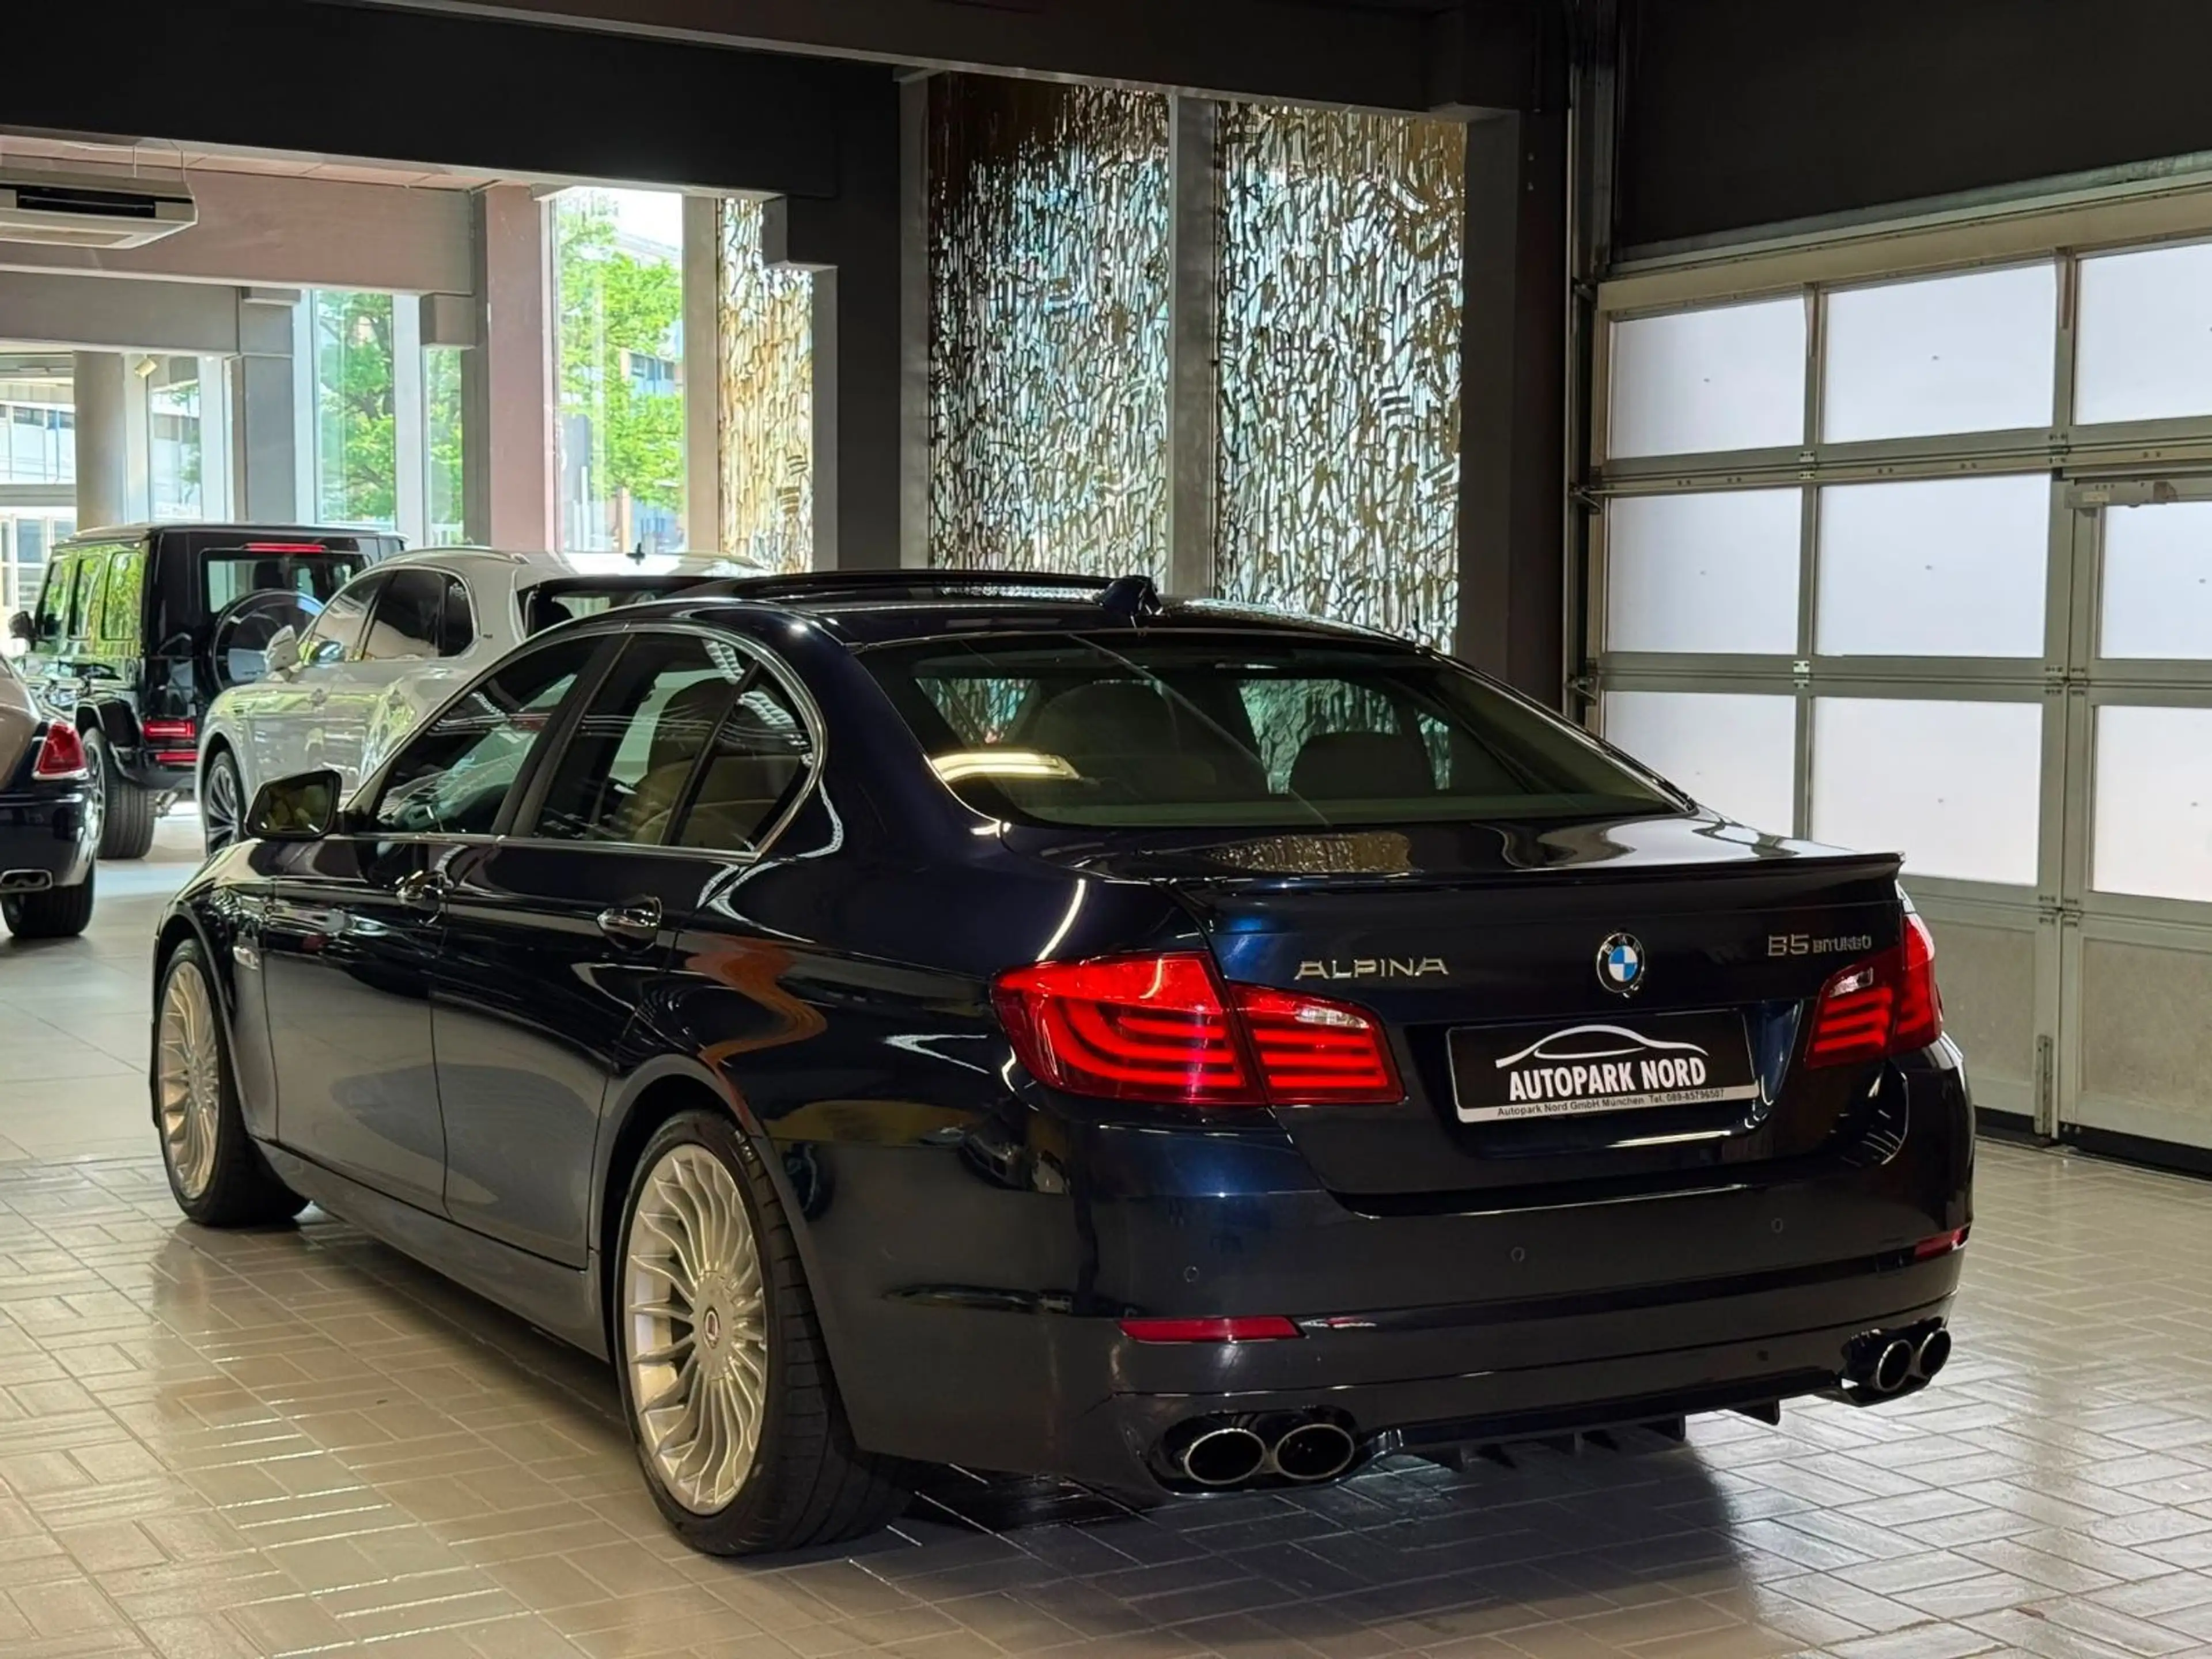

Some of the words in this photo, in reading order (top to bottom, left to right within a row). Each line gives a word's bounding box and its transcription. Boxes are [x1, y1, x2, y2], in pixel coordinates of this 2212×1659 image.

[1767, 933, 1810, 957] B5
[1293, 957, 1449, 980] ALPINA
[1509, 1062, 1635, 1101] AUTOPARK
[1641, 1057, 1707, 1089] NORD
[1497, 1105, 1542, 1117] Autopark
[1544, 1101, 1569, 1113] Nord
[1570, 1098, 1600, 1110] GmbH
[1602, 1096, 1645, 1107] München
